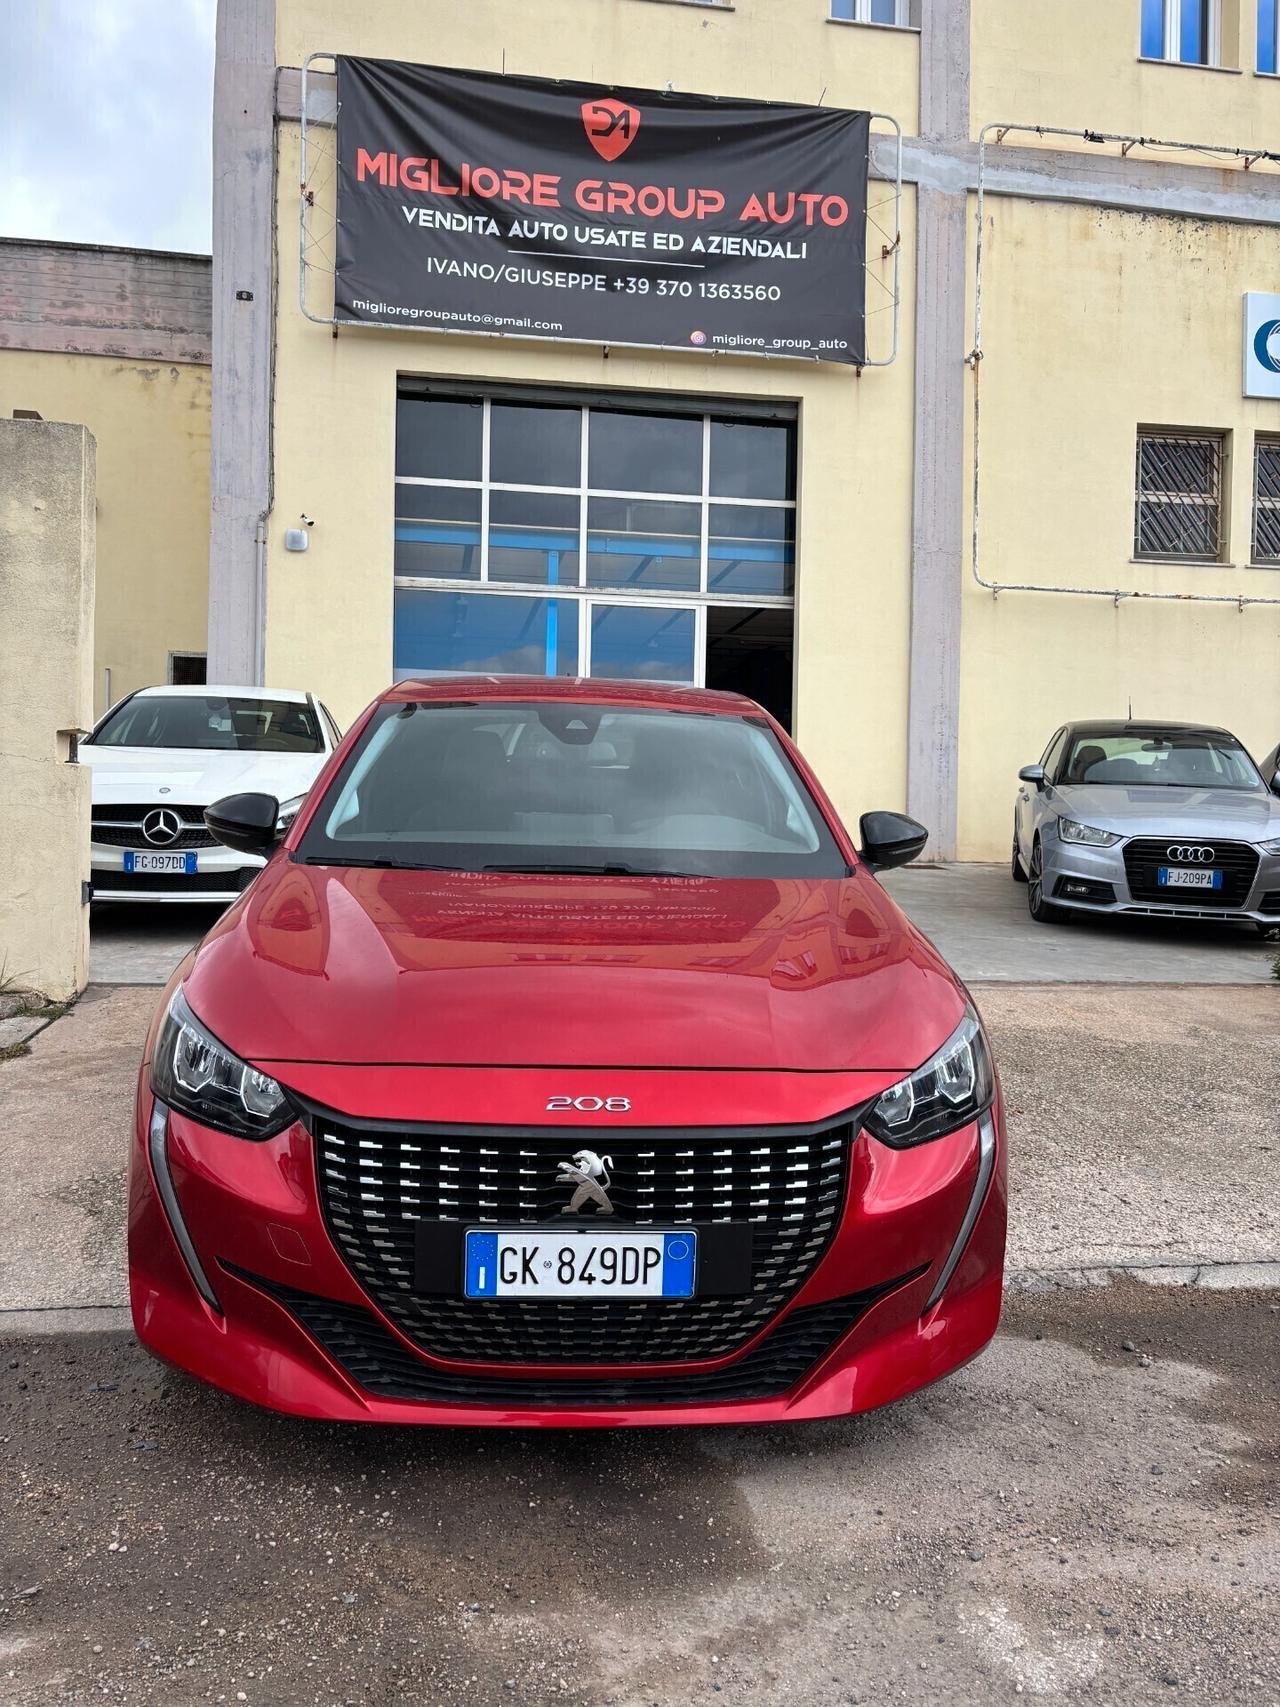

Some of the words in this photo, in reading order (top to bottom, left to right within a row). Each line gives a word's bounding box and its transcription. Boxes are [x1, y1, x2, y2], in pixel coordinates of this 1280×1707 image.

[356, 147, 562, 208] MIGLIORE
[575, 179, 726, 220] GROUP
[739, 191, 849, 227] AUTO
[402, 206, 501, 237] VENDITA
[508, 219, 568, 241] AUTO
[574, 226, 648, 249] USATE
[653, 233, 684, 251] ED
[690, 236, 807, 259] AZIENDALI
[427, 257, 607, 292] IVANO/GIUSEPPE
[613, 277, 650, 295] +39
[656, 280, 693, 297] 370
[698, 282, 782, 301] 1363560
[352, 299, 563, 331] miglioregroupauto@gmail.com
[712, 334, 848, 350] migliore_group_auto
[545, 1096, 631, 1112] 208
